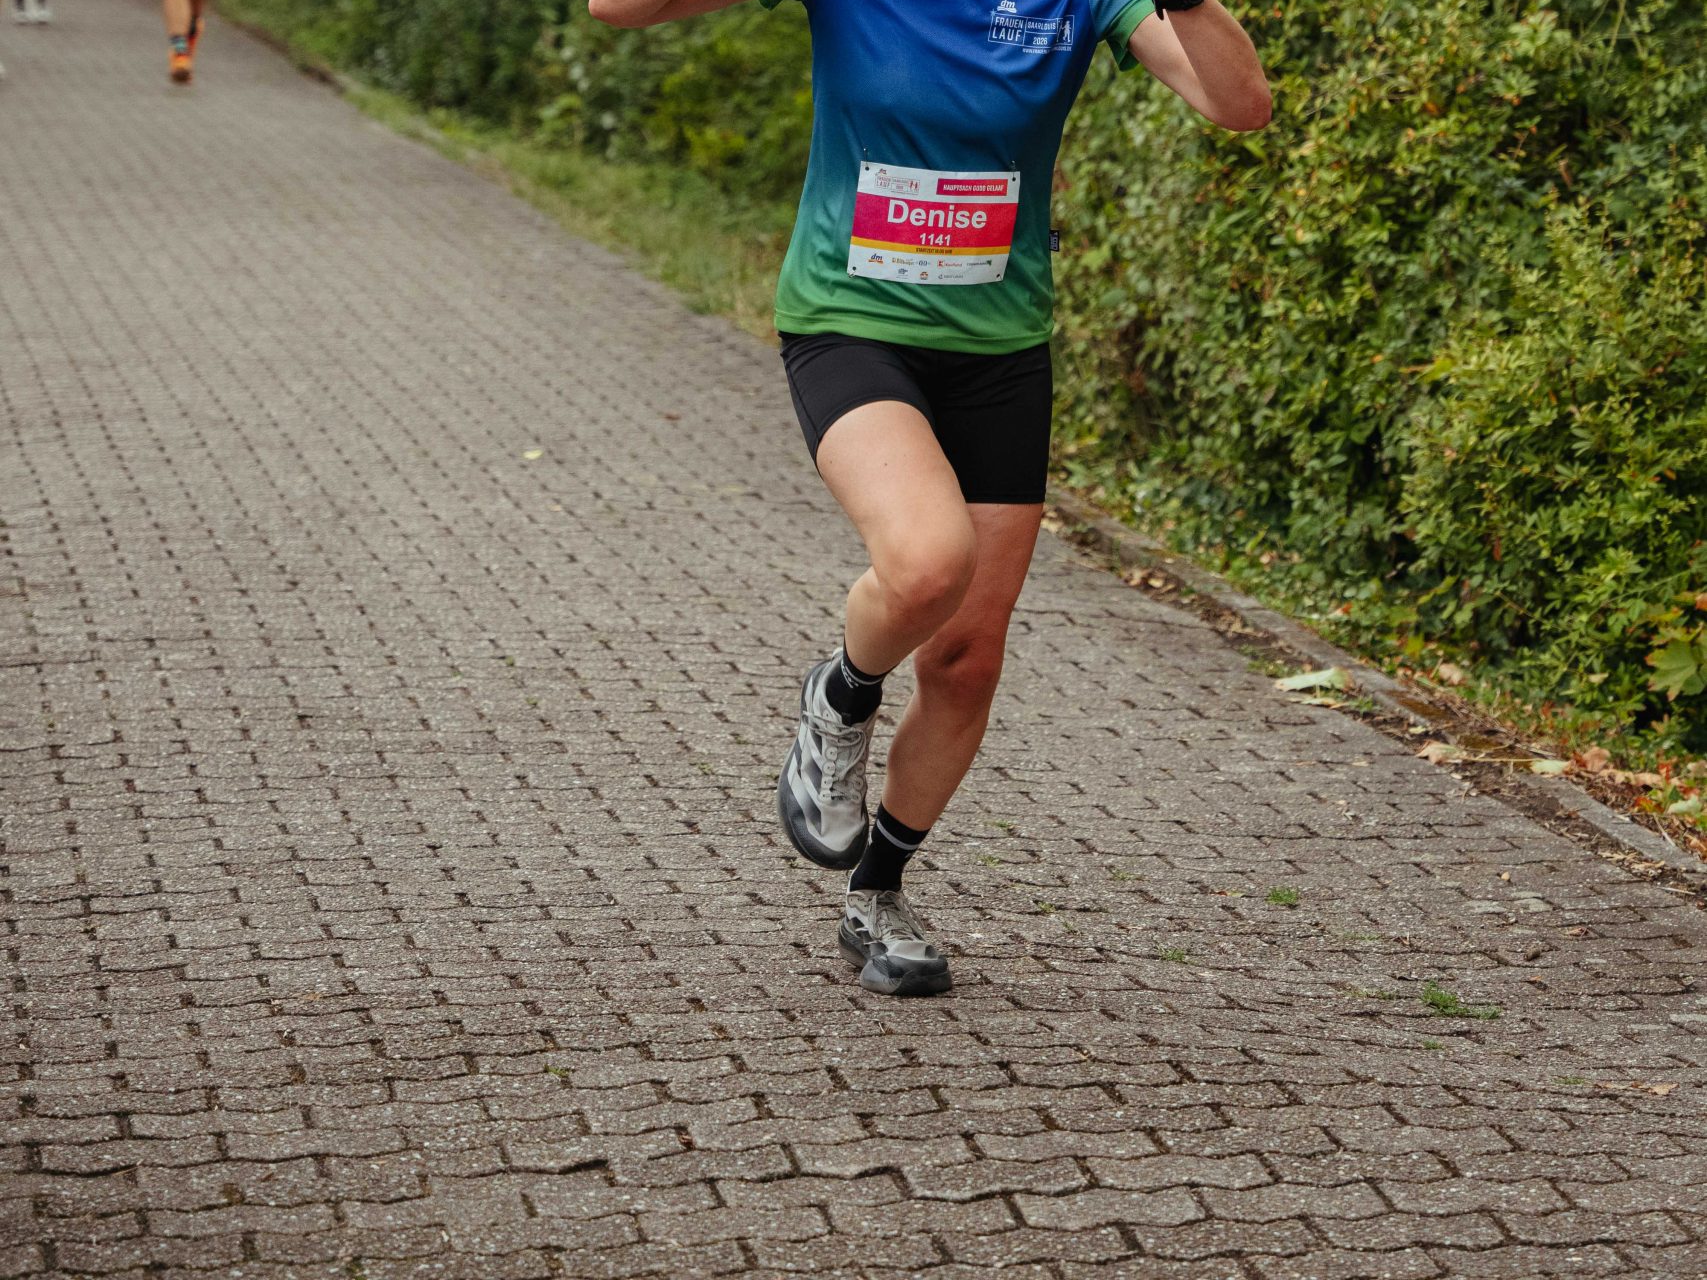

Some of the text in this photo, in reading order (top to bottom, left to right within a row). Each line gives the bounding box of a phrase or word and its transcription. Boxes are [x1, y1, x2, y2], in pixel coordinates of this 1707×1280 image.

[994, 16, 1024, 29] FRAUEN
[1027, 21, 1056, 31] SAARLOUIS
[992, 27, 1022, 42] LAUF
[887, 199, 987, 229] Denise
[920, 233, 951, 246] 1141
